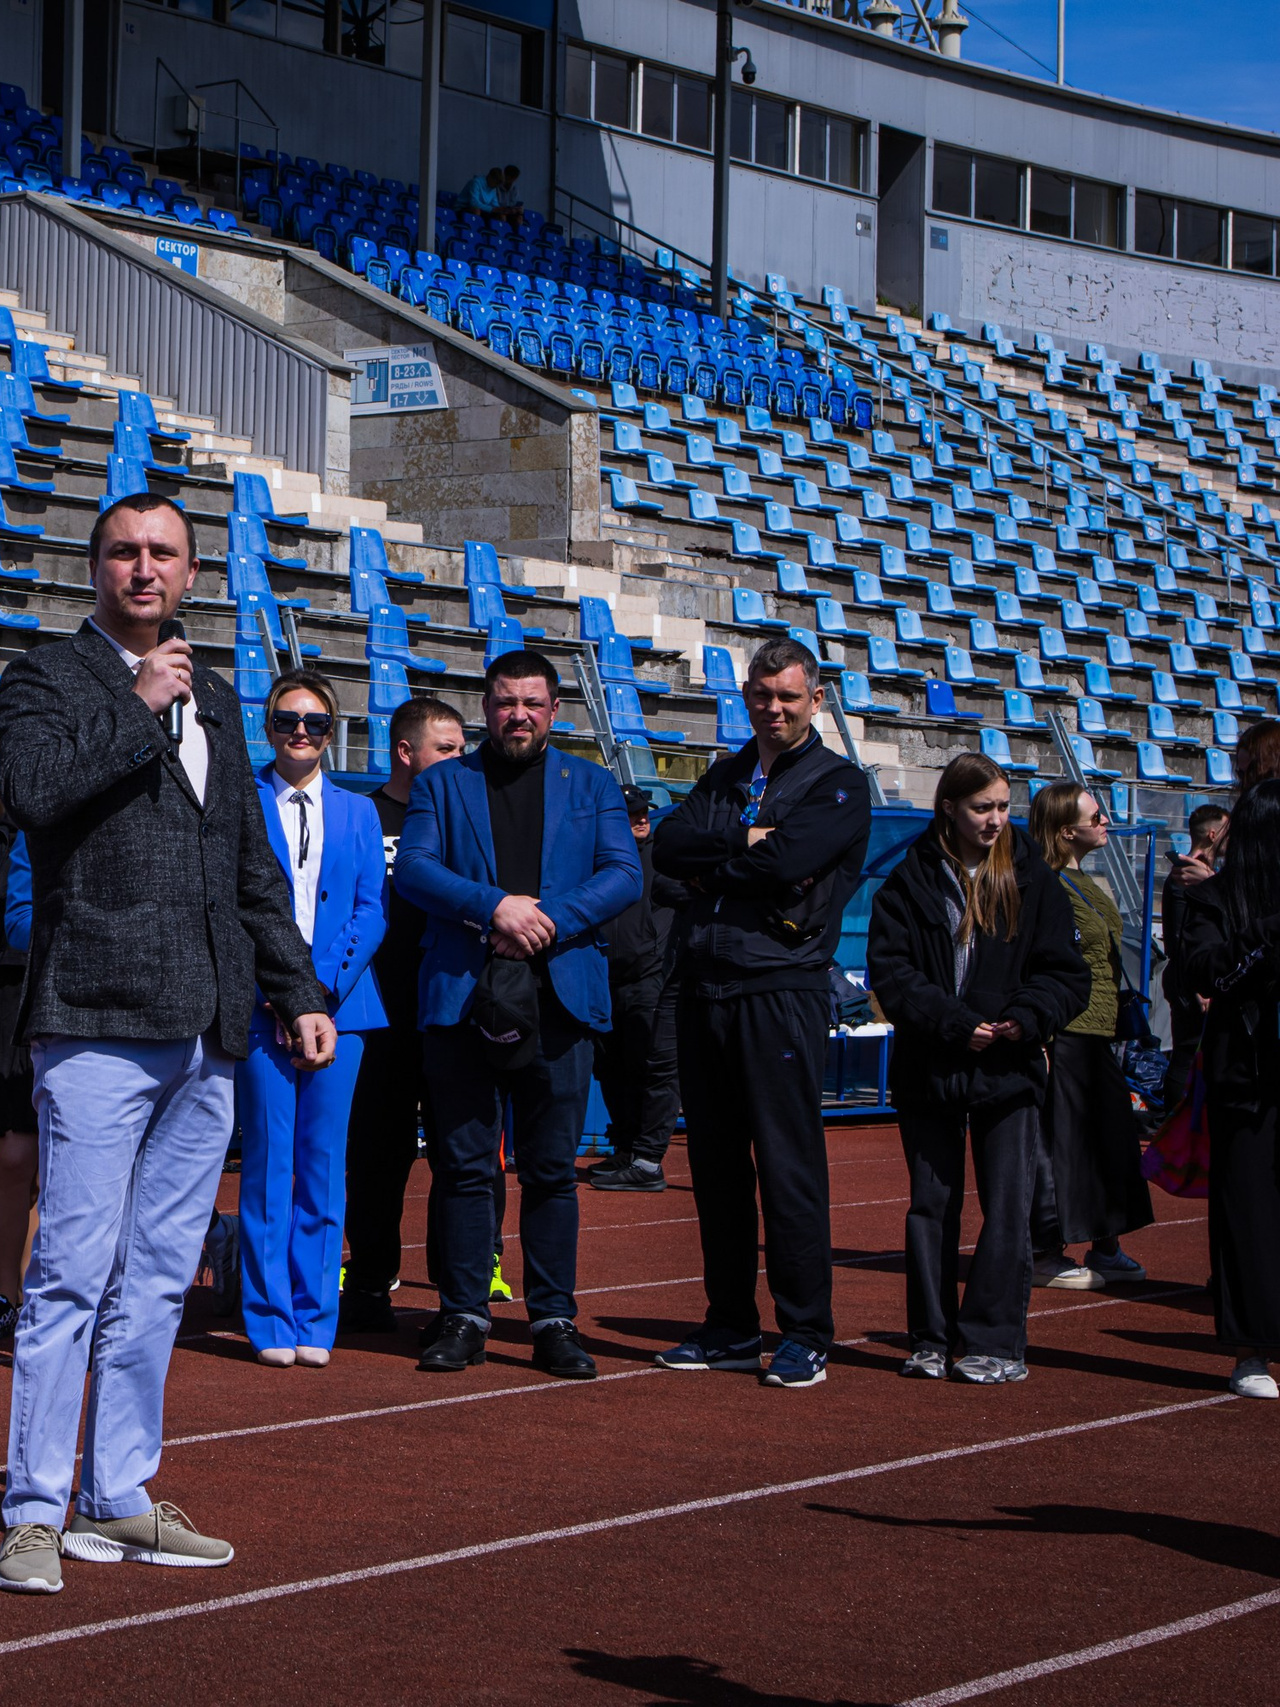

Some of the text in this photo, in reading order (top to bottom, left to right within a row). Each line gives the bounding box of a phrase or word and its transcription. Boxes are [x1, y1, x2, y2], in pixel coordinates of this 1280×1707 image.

[158, 240, 197, 257] СЕКТОР
[412, 346, 427, 358] №1
[394, 365, 416, 378] 8-23
[391, 382, 410, 390] РЯДЫ
[414, 380, 434, 388] ROWS
[394, 394, 409, 407] 1-7
